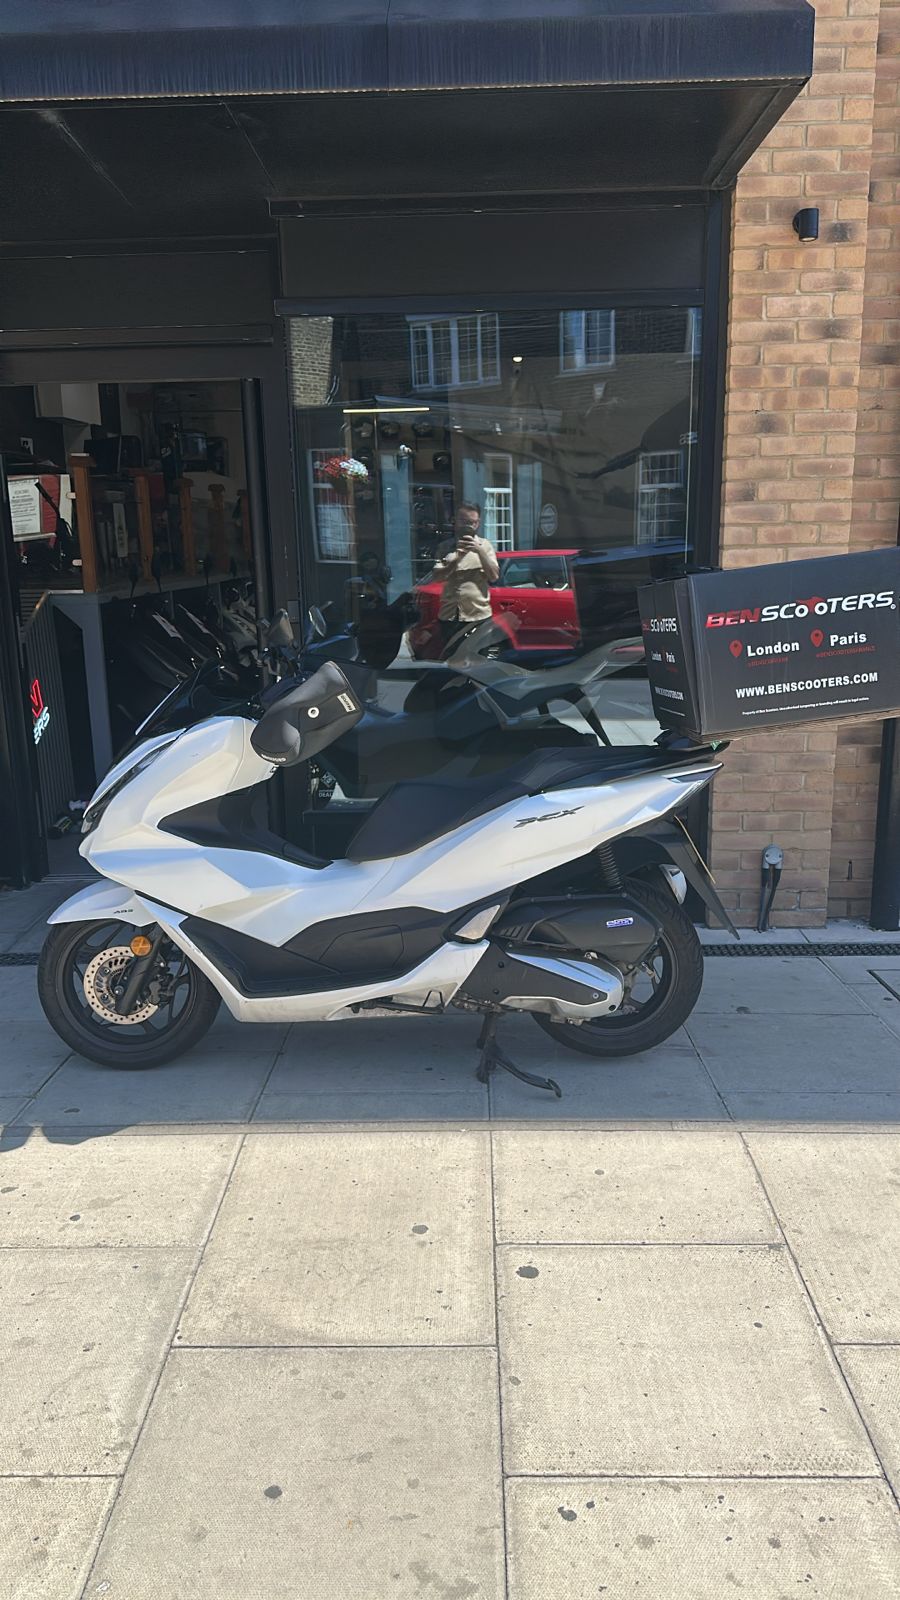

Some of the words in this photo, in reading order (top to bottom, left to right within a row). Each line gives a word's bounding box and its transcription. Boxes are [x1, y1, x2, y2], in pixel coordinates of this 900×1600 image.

[747, 641, 800, 657] London
[830, 631, 867, 647] Paris
[735, 672, 878, 699] WWW.BENSCOOTERS.COM
